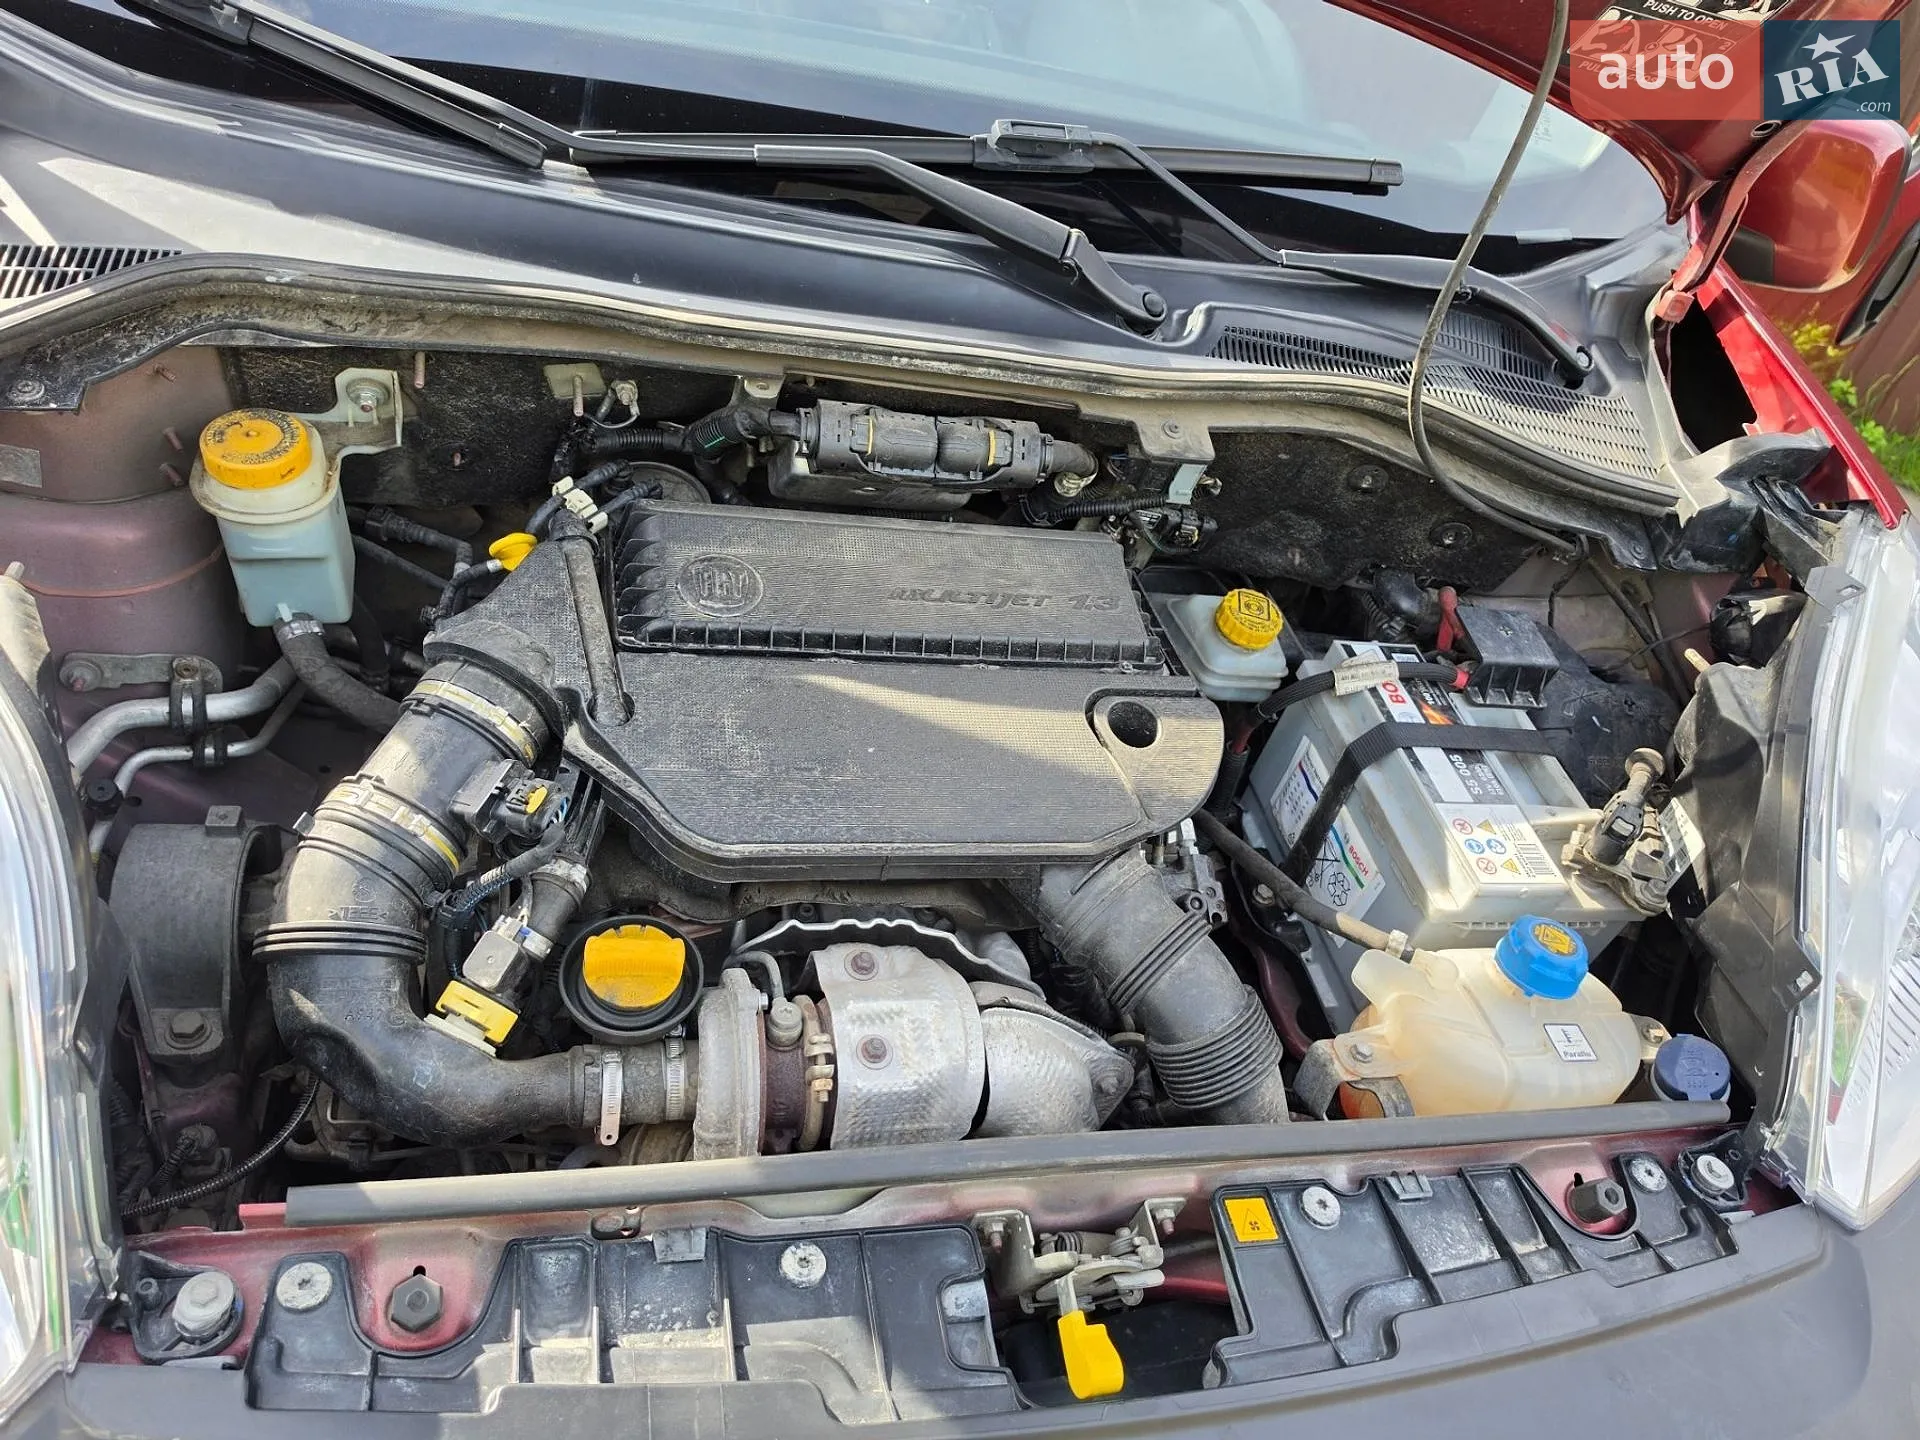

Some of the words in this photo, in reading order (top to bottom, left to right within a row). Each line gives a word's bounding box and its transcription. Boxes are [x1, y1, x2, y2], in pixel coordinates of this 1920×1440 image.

[1643, 1, 1678, 16] PUSH
[1678, 9, 1696, 20] TO
[1694, 14, 1728, 31] OPEN
[1349, 845, 1370, 877] BOSCH
